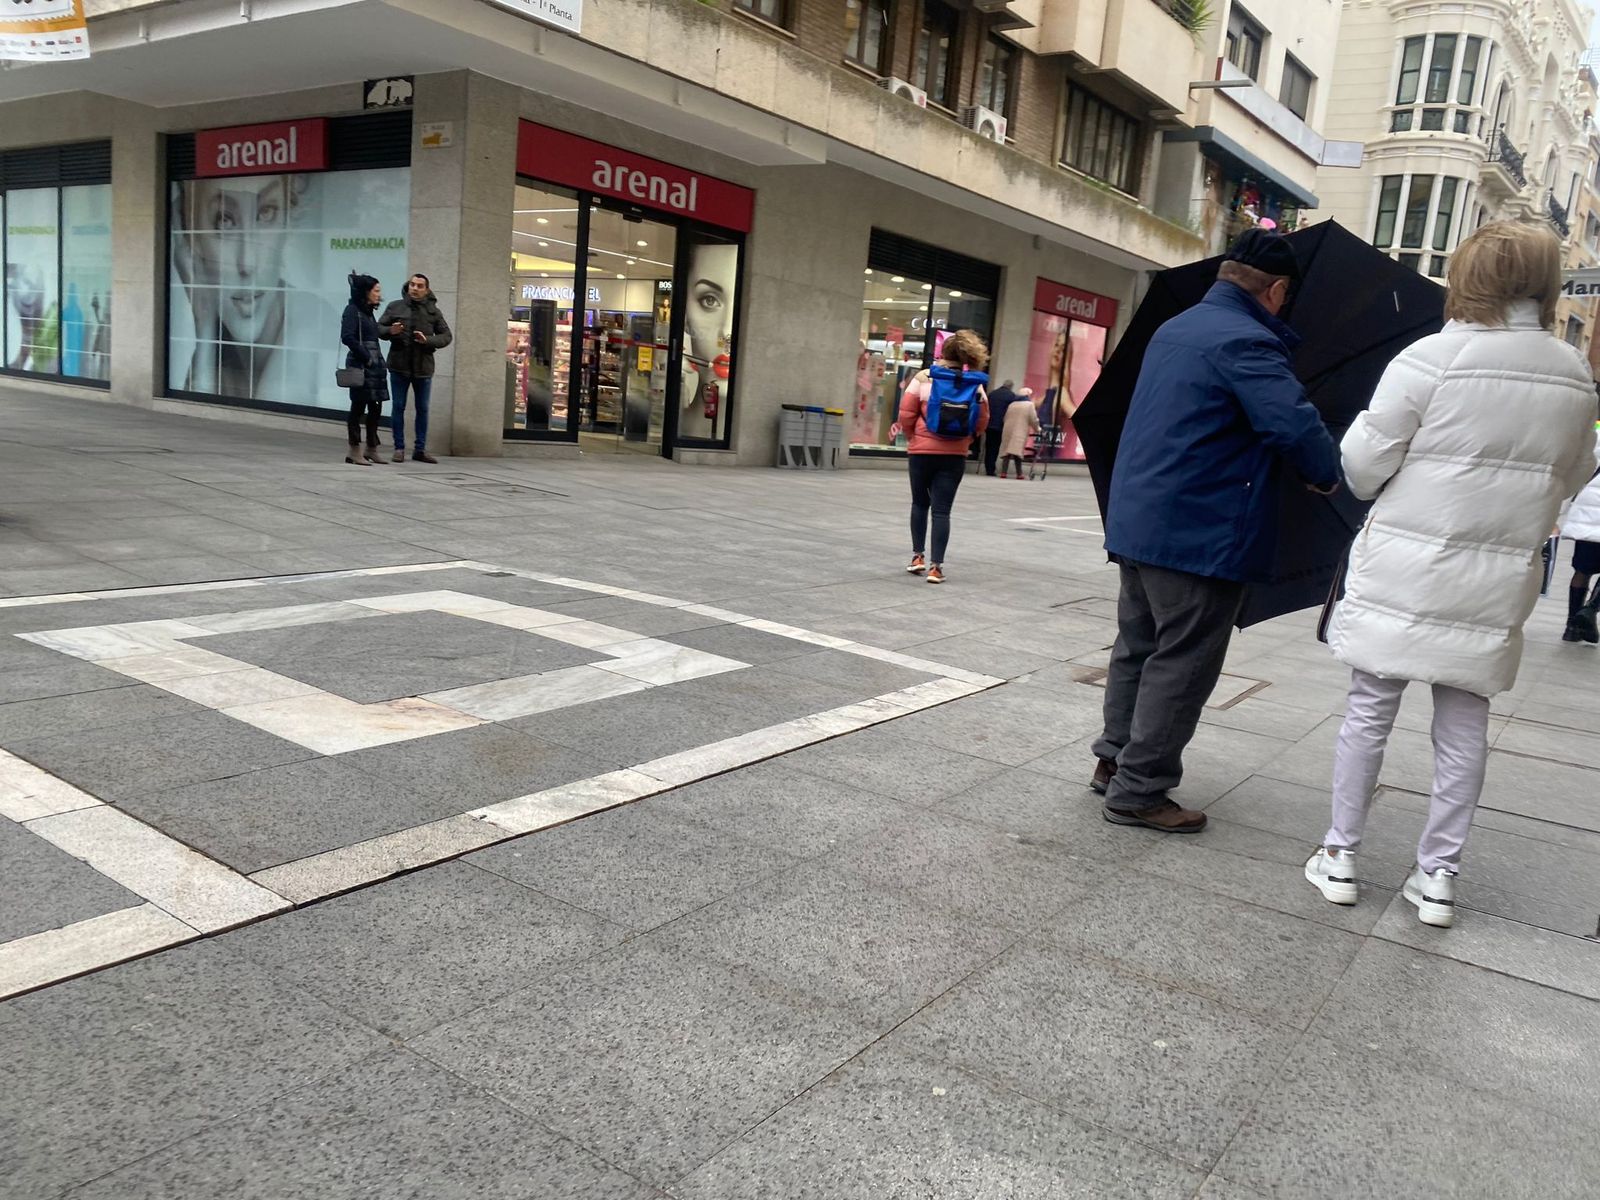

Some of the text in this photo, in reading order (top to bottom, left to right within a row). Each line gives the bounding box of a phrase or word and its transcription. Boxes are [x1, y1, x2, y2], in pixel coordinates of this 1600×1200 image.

[549, 4, 573, 20] Planta
[216, 126, 297, 169] arenal
[592, 160, 697, 211] arenal
[330, 237, 405, 250] PARAFARMACIA
[1056, 294, 1098, 319] arenal
